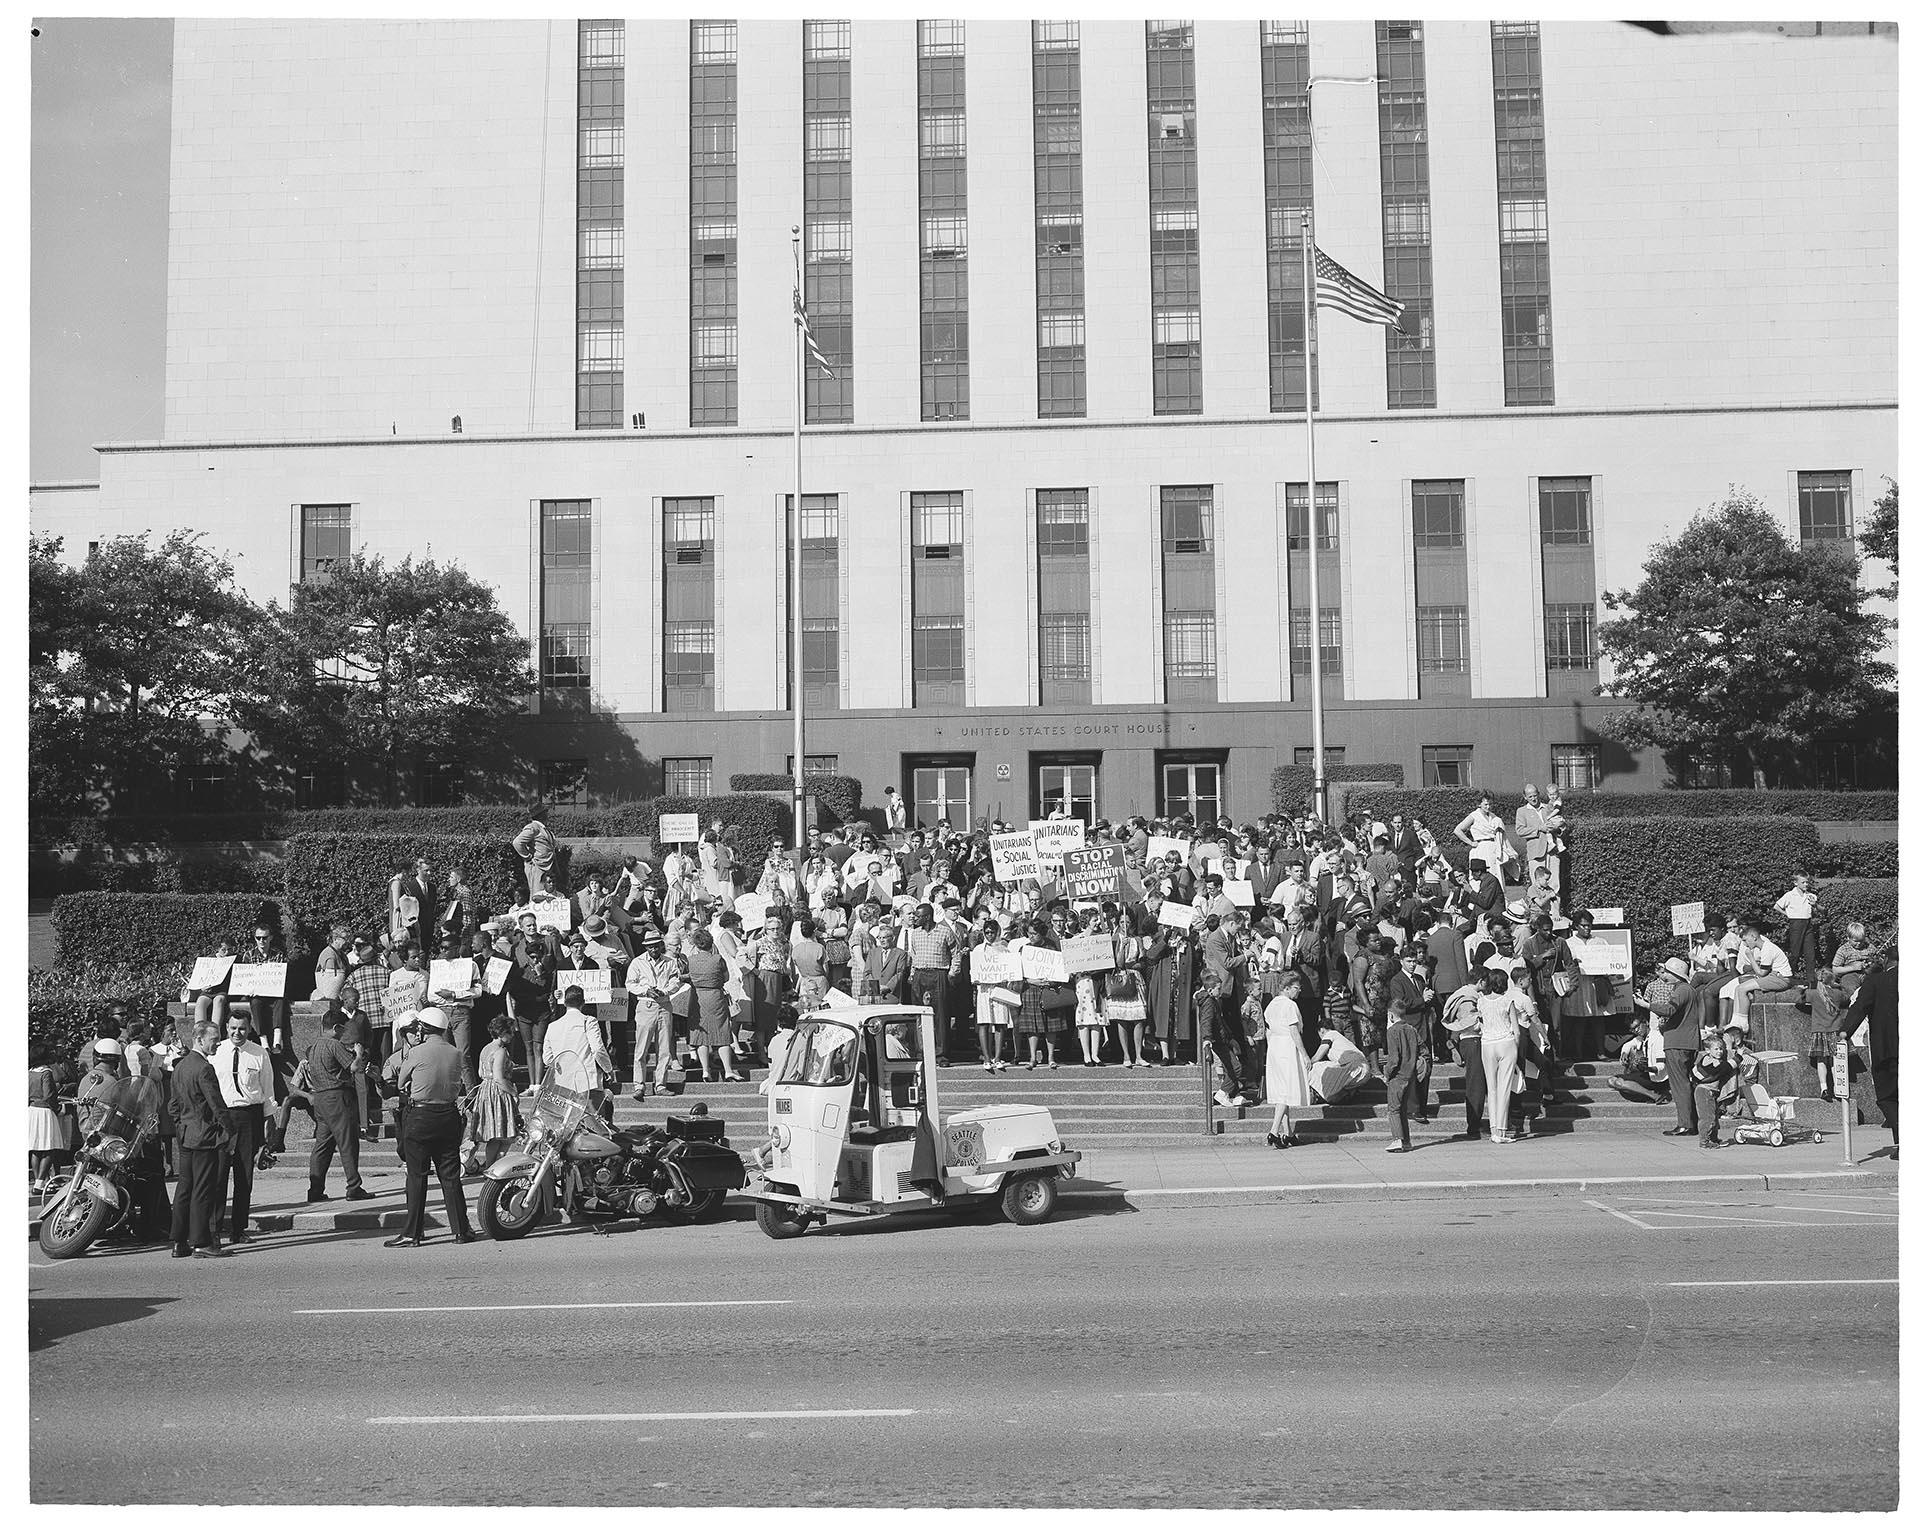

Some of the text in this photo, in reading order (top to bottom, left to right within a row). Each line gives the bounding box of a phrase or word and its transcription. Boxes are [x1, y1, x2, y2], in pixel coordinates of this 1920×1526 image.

[961, 724, 1170, 736] UNITED STATES COURT HOUSE
[1034, 825, 1079, 839] UNITARIANS
[993, 836, 1032, 850] UNITARIANS
[1003, 850, 1031, 864] SOCIAL
[1038, 852, 1055, 860] OCIAL
[1070, 847, 1114, 864] STOP
[1012, 864, 1037, 876] JUSTICE
[1080, 861, 1112, 871] RACIAL
[1075, 878, 1115, 896] NOW
[533, 900, 568, 912] CORE
[1678, 920, 1703, 934] PAX
[984, 955, 998, 963] WE
[980, 964, 1008, 972] WANT
[1609, 962, 1628, 970] NOW
[559, 970, 606, 984] WRITE
[977, 972, 1015, 981] JUSTICE
[380, 981, 416, 998] WE MOURN
[388, 994, 414, 1007] JAMES
[387, 1002, 418, 1018] CHANEY
[951, 1130, 977, 1143] SEATTLE
[511, 1163, 536, 1173] POLICE
[955, 1156, 978, 1167] POLICE
[85, 1175, 101, 1189] POLICE
